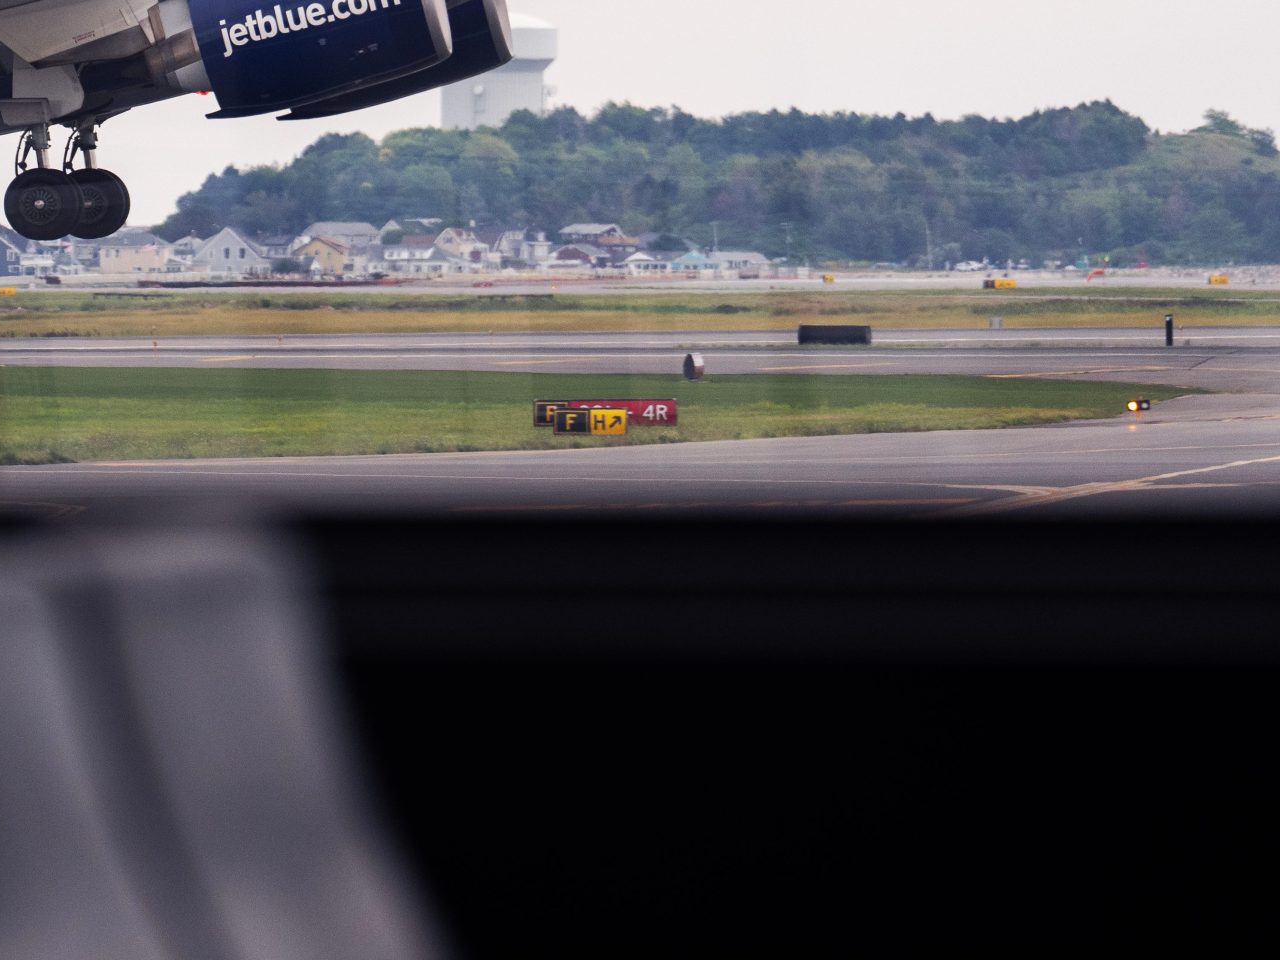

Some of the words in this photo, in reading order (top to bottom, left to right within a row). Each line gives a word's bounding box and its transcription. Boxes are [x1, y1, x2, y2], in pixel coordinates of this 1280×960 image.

[642, 404, 668, 421] 4R
[565, 413, 577, 430] F
[593, 414, 606, 431] H
